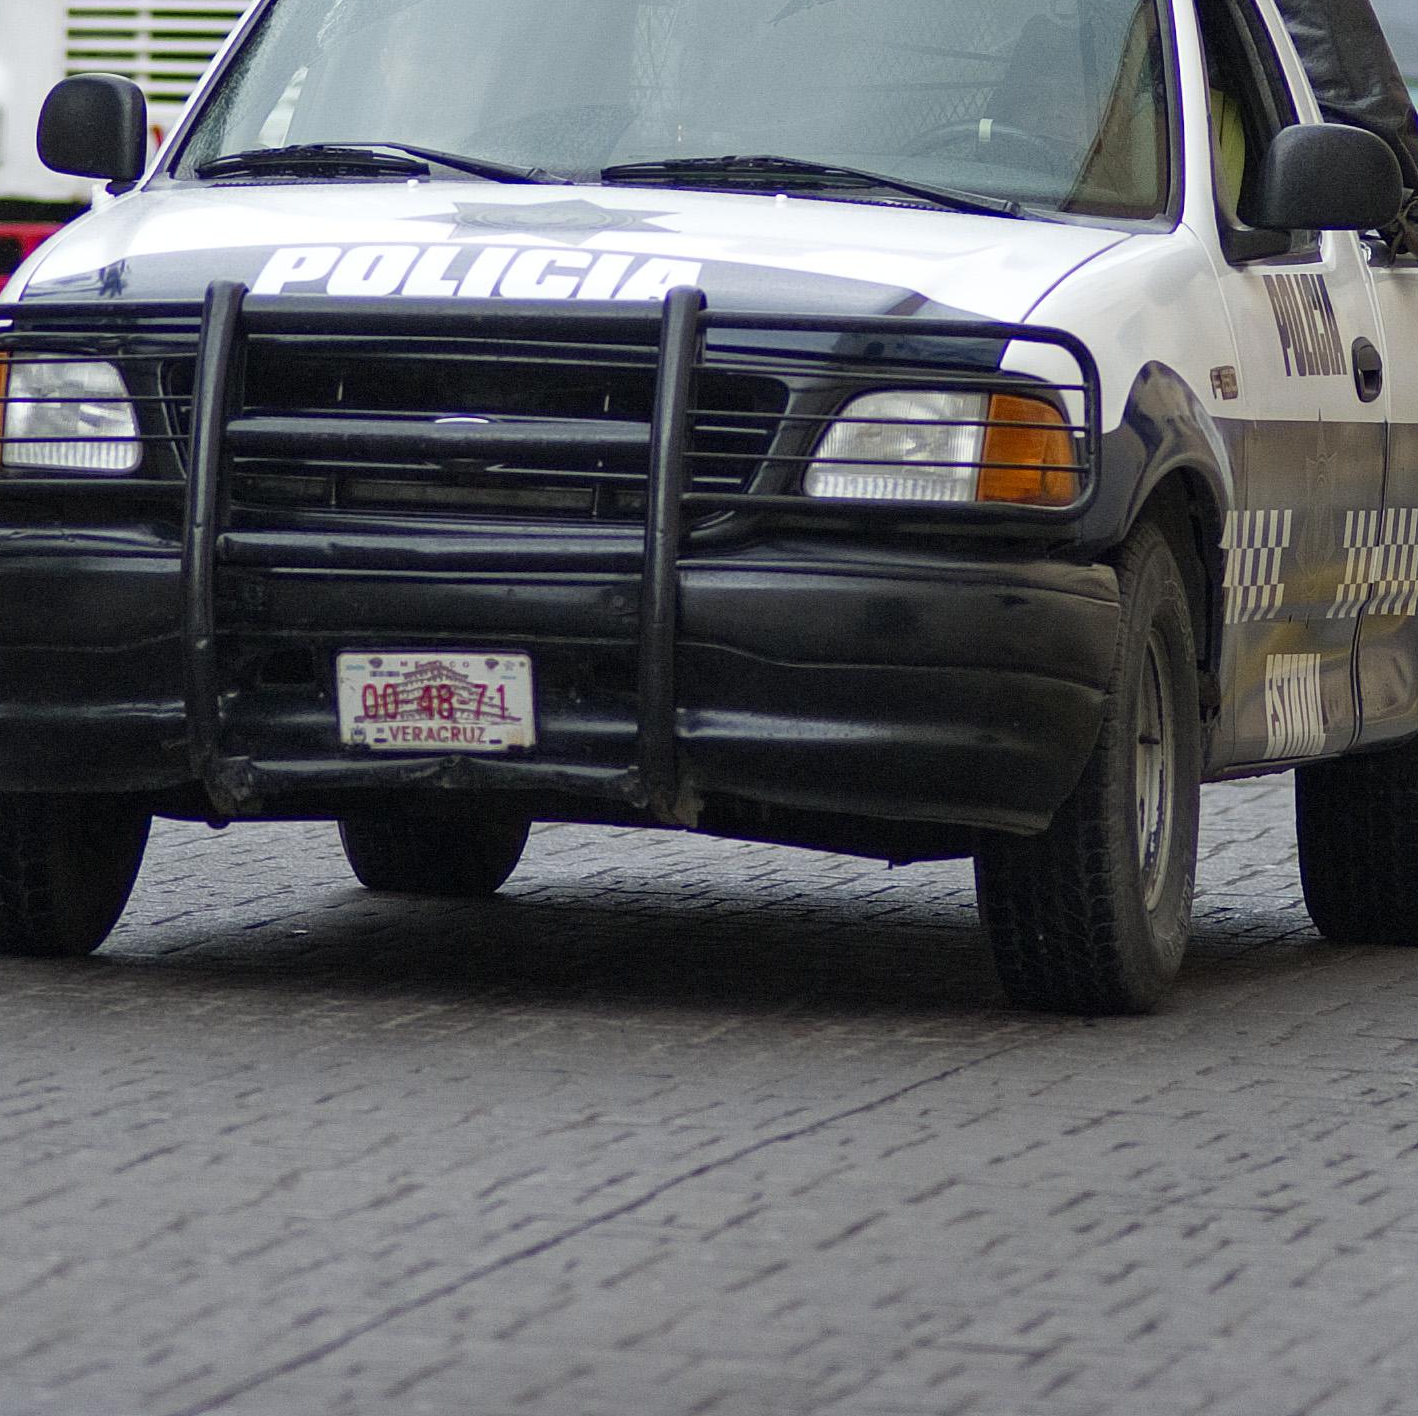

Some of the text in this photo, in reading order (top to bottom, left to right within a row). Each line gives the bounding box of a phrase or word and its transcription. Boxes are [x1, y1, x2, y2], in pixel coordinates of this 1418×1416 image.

[249, 245, 703, 300] POLICIA
[1260, 274, 1348, 377] POLICIA
[389, 725, 487, 745] VERACRUZ
[1262, 653, 1326, 759] ESTATAL
